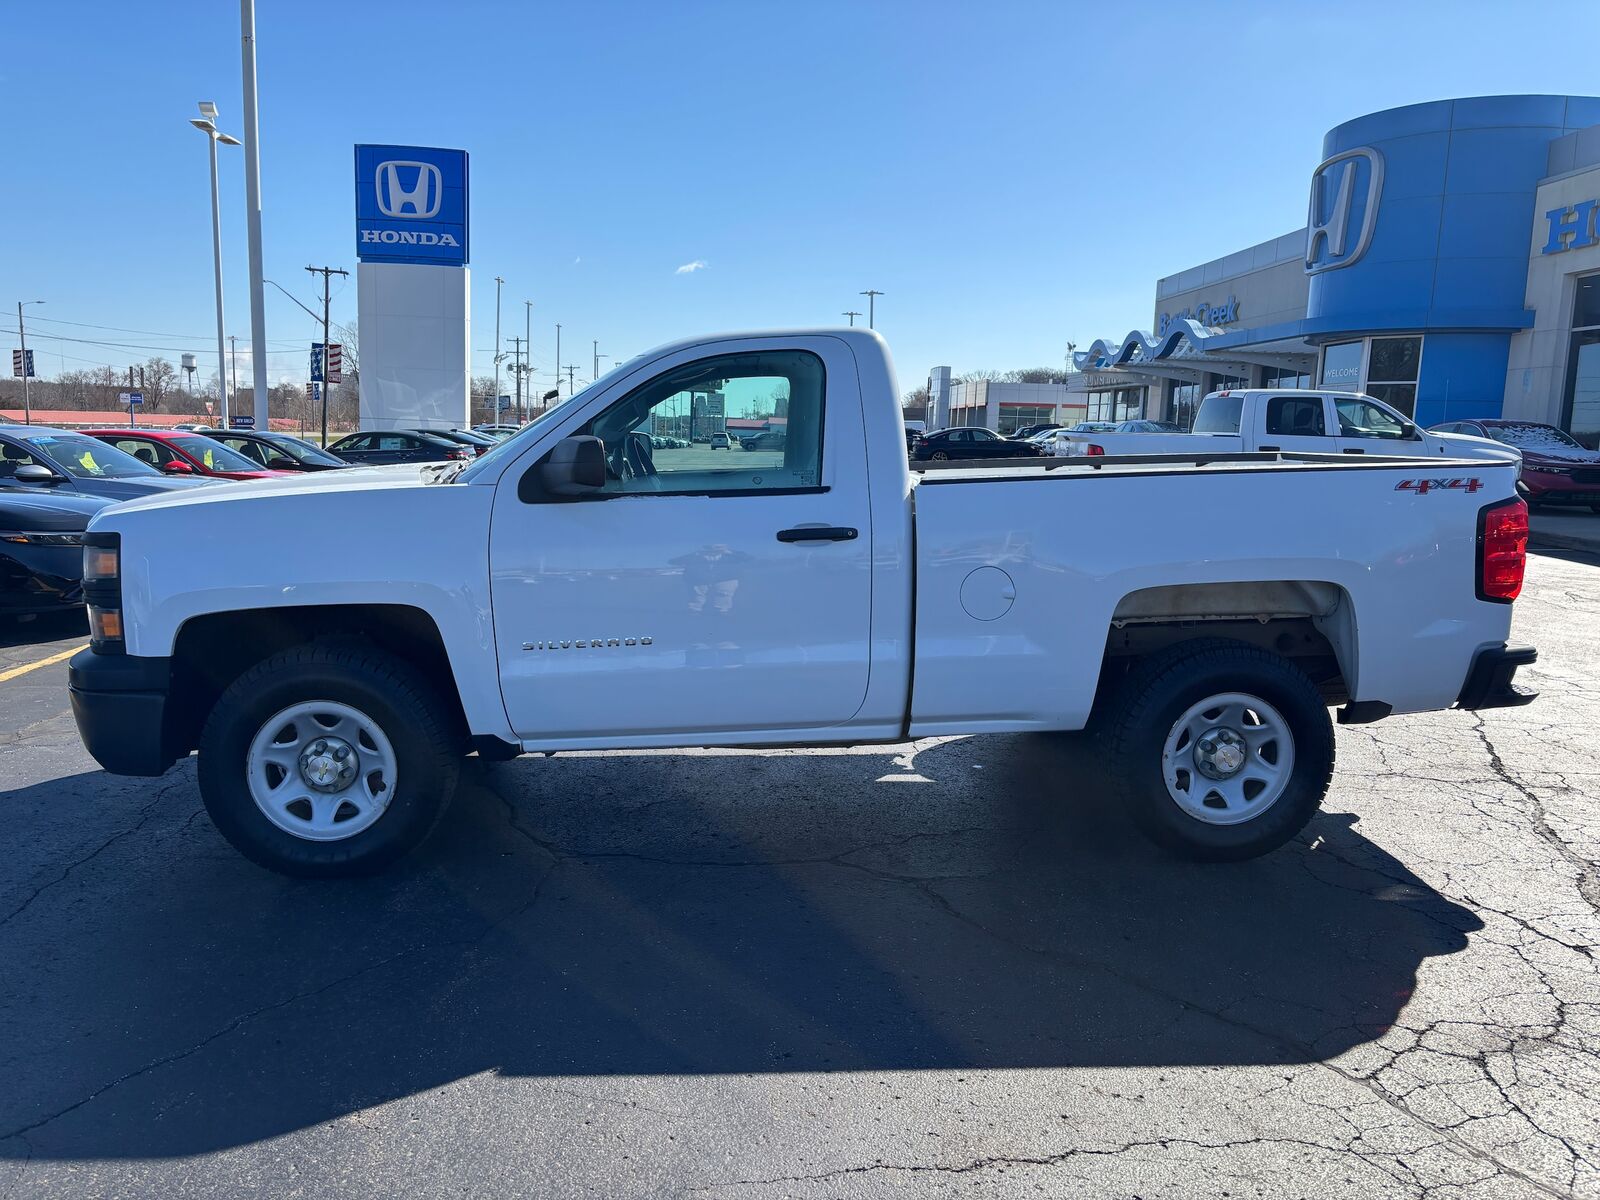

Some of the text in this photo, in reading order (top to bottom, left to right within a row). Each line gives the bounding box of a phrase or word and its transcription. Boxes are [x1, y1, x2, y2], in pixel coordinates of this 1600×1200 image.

[1541, 199, 1600, 254] H
[361, 230, 460, 247] HONDA
[1197, 295, 1239, 328] Creek
[1325, 367, 1359, 378] WELCOME
[522, 636, 652, 650] SILVERADO
